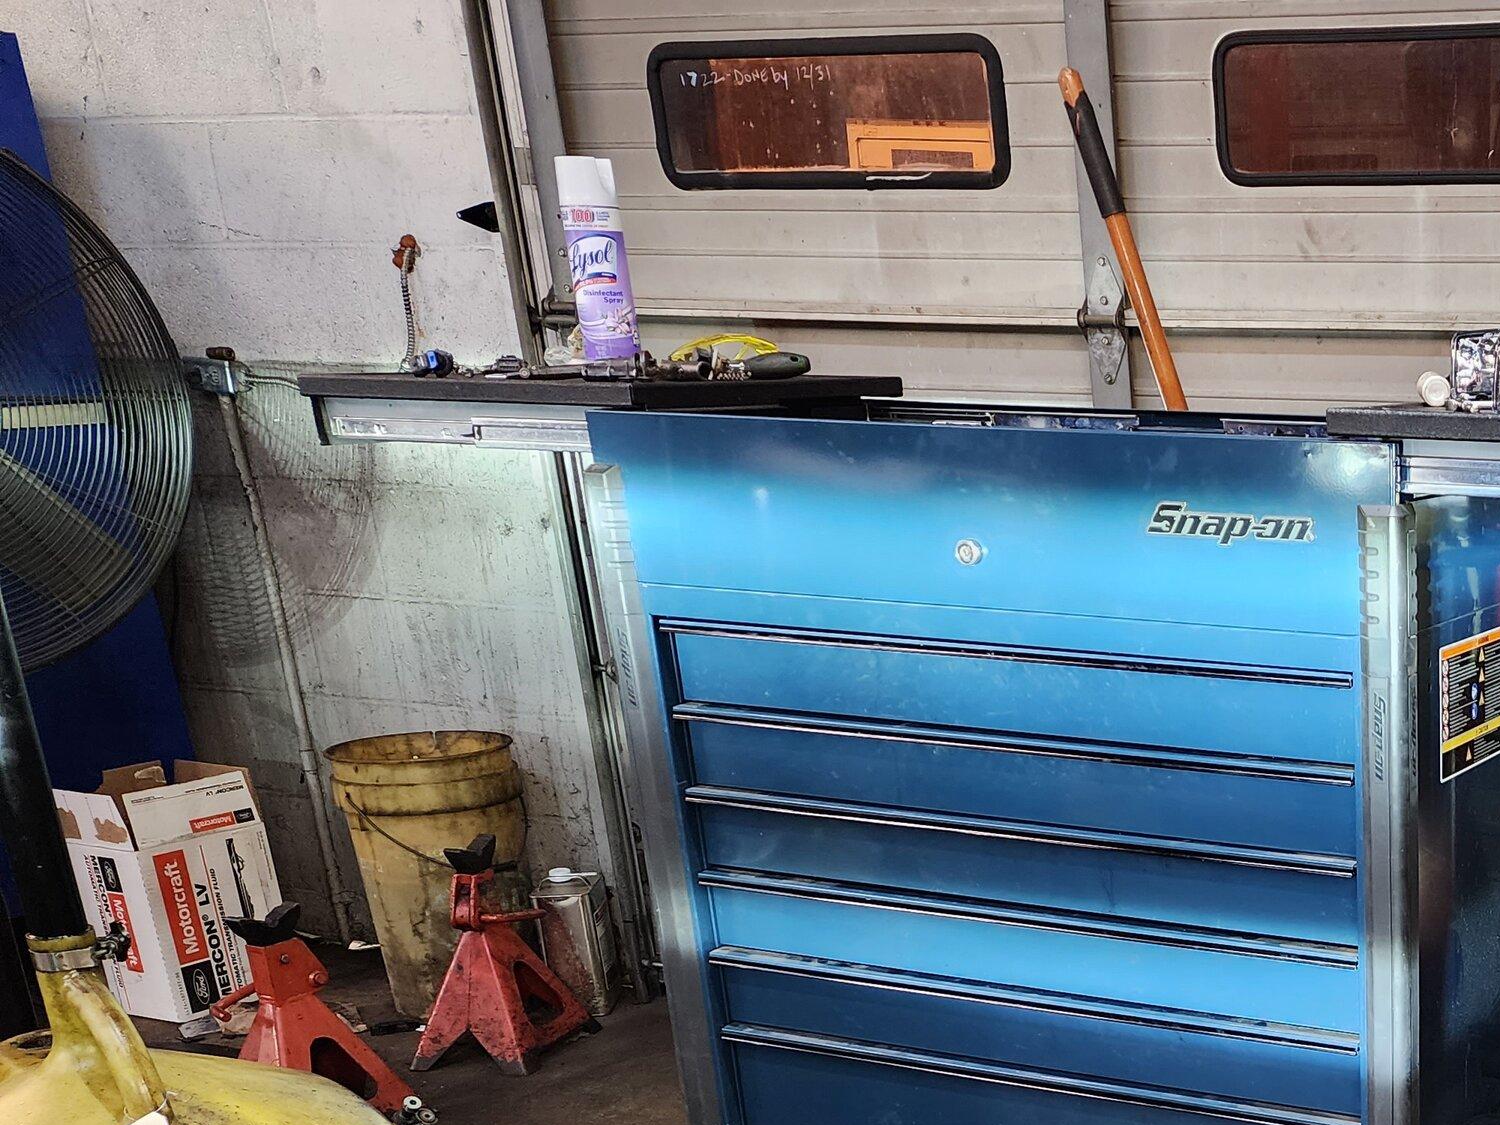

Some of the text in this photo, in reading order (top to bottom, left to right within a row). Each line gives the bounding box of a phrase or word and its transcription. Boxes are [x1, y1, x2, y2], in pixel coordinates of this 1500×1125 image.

[771, 66, 789, 90] by
[796, 64, 831, 90] 12/31
[570, 240, 613, 278] Lysol
[603, 296, 624, 304] Spray
[1147, 502, 1315, 544] Snap-on
[194, 815, 231, 829] Motorcraft
[209, 868, 221, 891] FLUID
[164, 858, 200, 955] Motorcraft
[194, 883, 210, 907] LV
[194, 972, 209, 999] Ford
